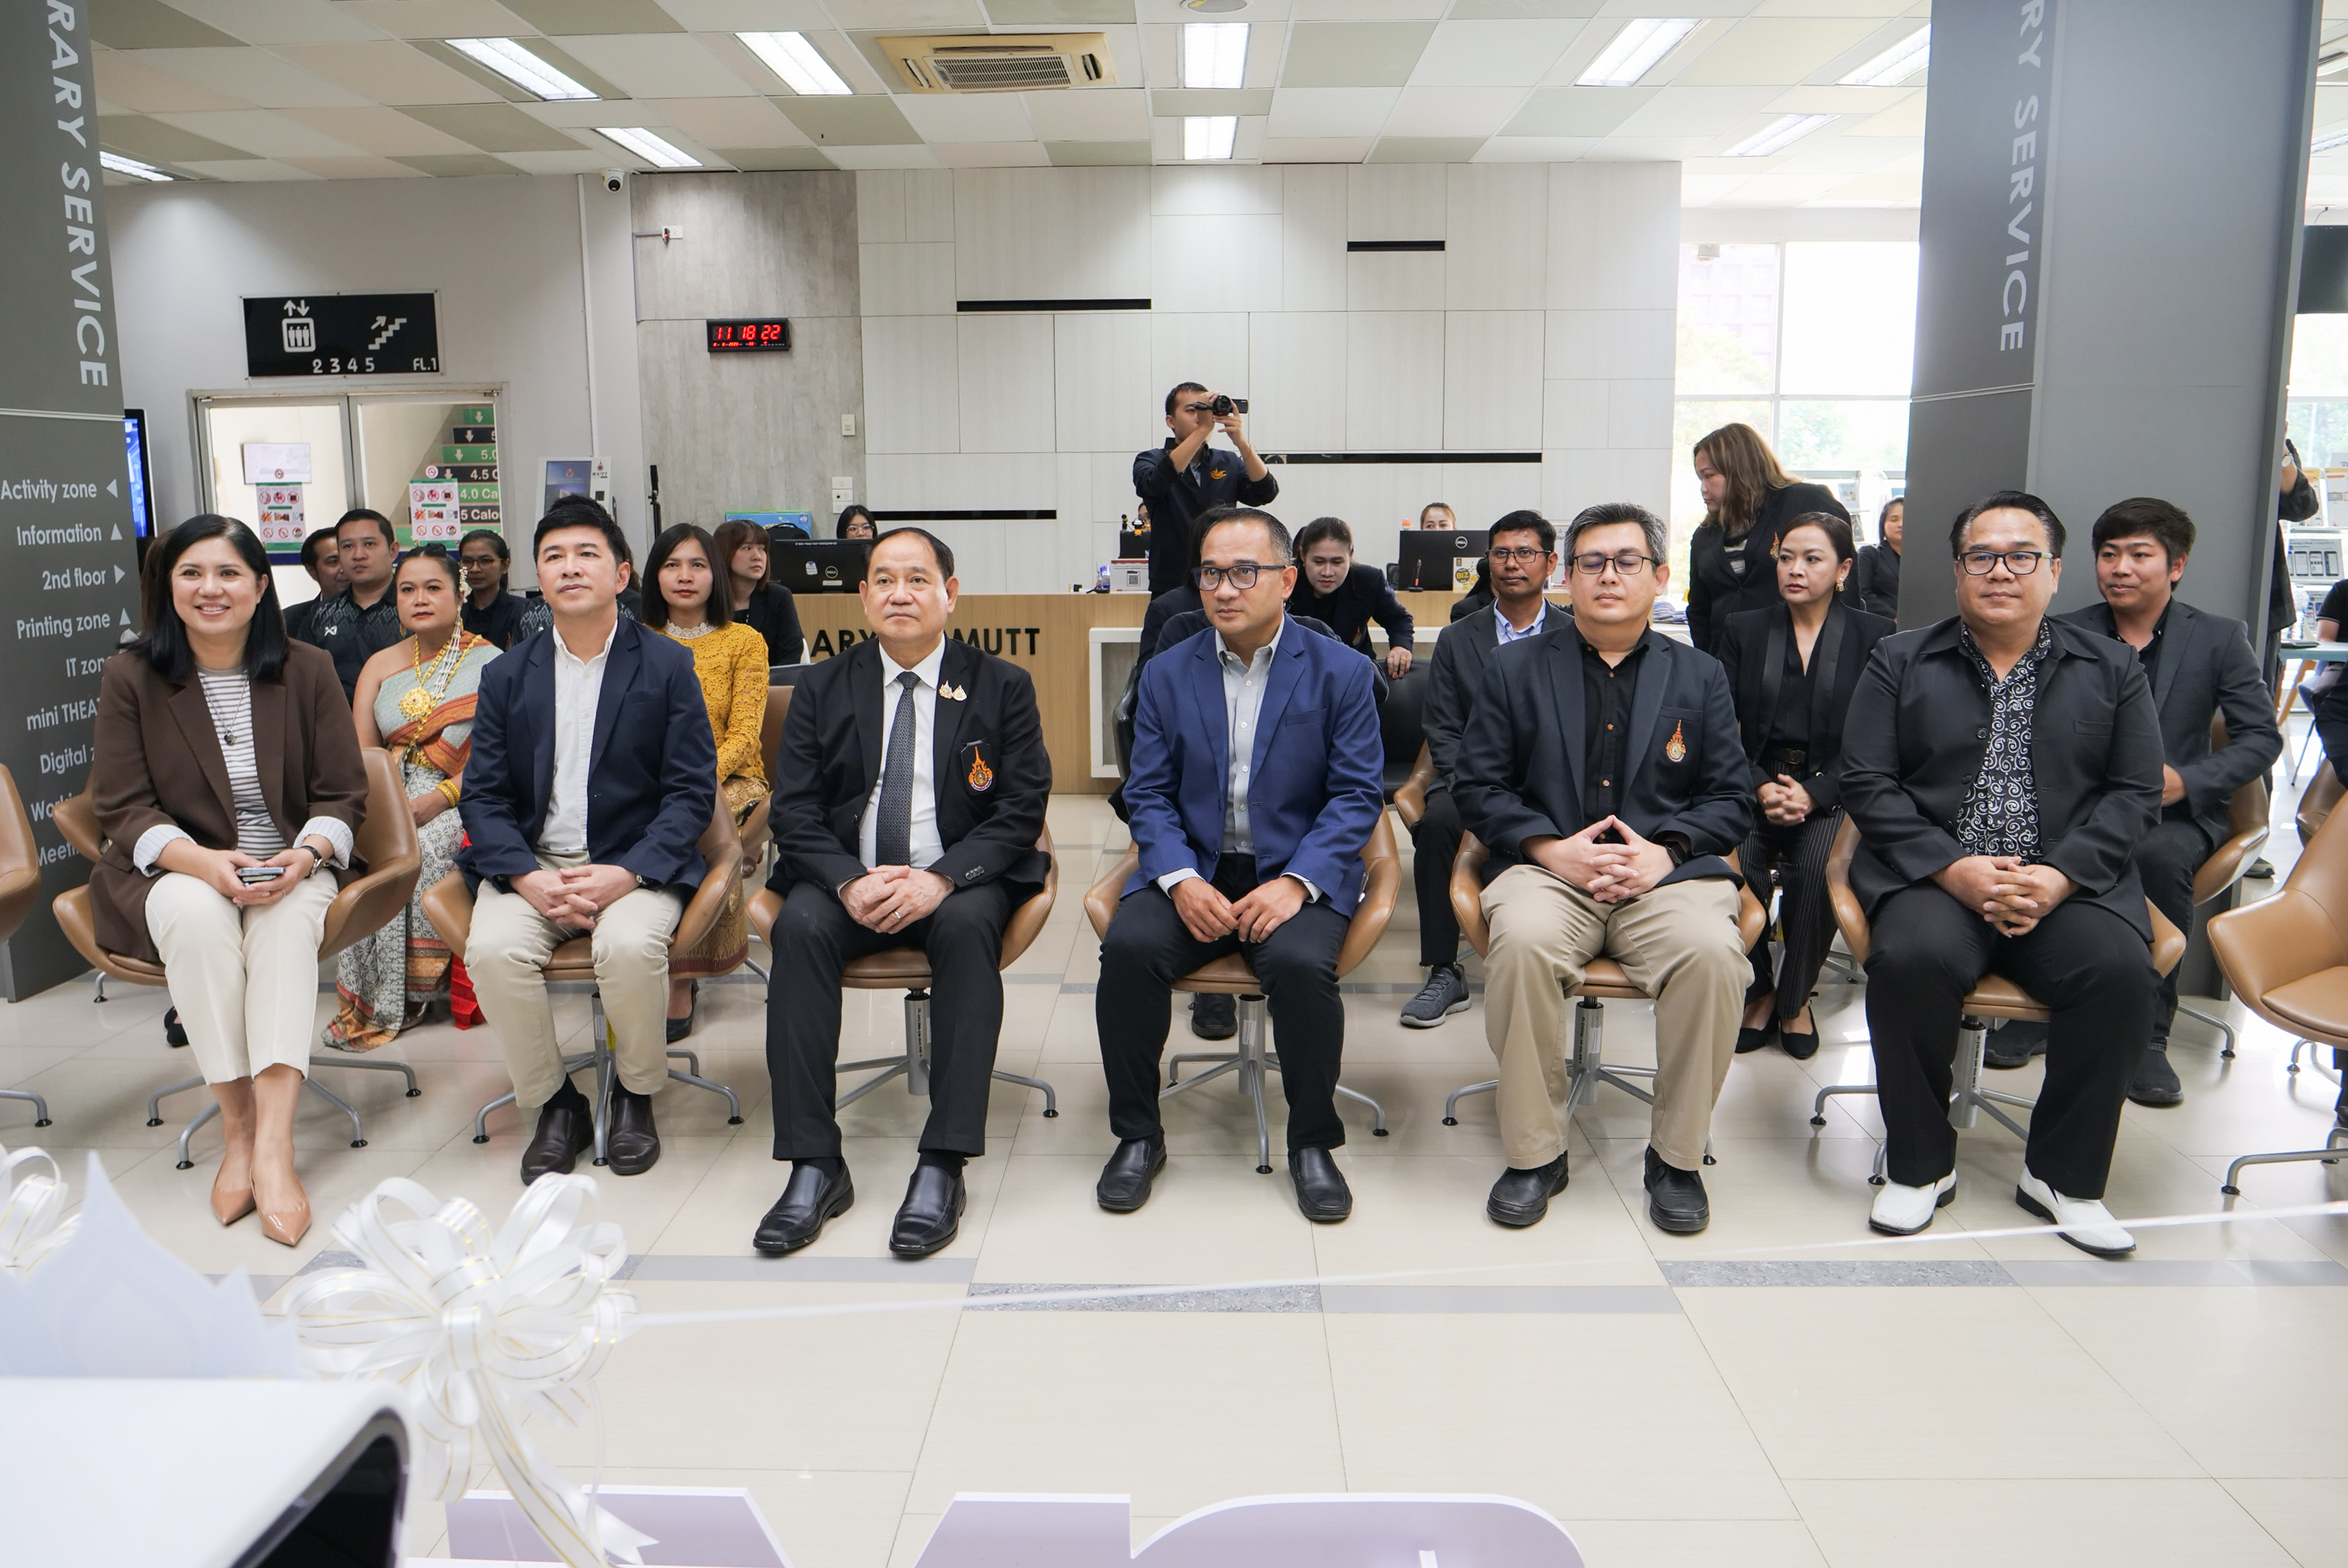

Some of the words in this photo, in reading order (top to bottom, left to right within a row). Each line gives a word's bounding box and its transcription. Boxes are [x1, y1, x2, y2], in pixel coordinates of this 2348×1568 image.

[2000, 95, 2039, 351] SERVICE
[61, 162, 108, 386] SERVICE
[742, 325, 757, 340] 18
[760, 324, 782, 340] 22
[312, 359, 323, 374] 2
[330, 357, 341, 373] 3
[347, 357, 358, 373] 4
[365, 357, 375, 372] 5
[470, 468, 489, 480] 4.5
[1, 479, 57, 503] Activity
[62, 483, 97, 498] zone
[460, 489, 479, 499] 4.0
[16, 523, 102, 545] Information
[42, 568, 71, 590] 2nd
[74, 567, 106, 587] floor
[16, 616, 73, 640] Printing
[77, 613, 111, 632] zone
[66, 657, 77, 678] IT
[80, 655, 111, 675] zon
[26, 706, 59, 731] mini
[40, 744, 86, 775] Digital
